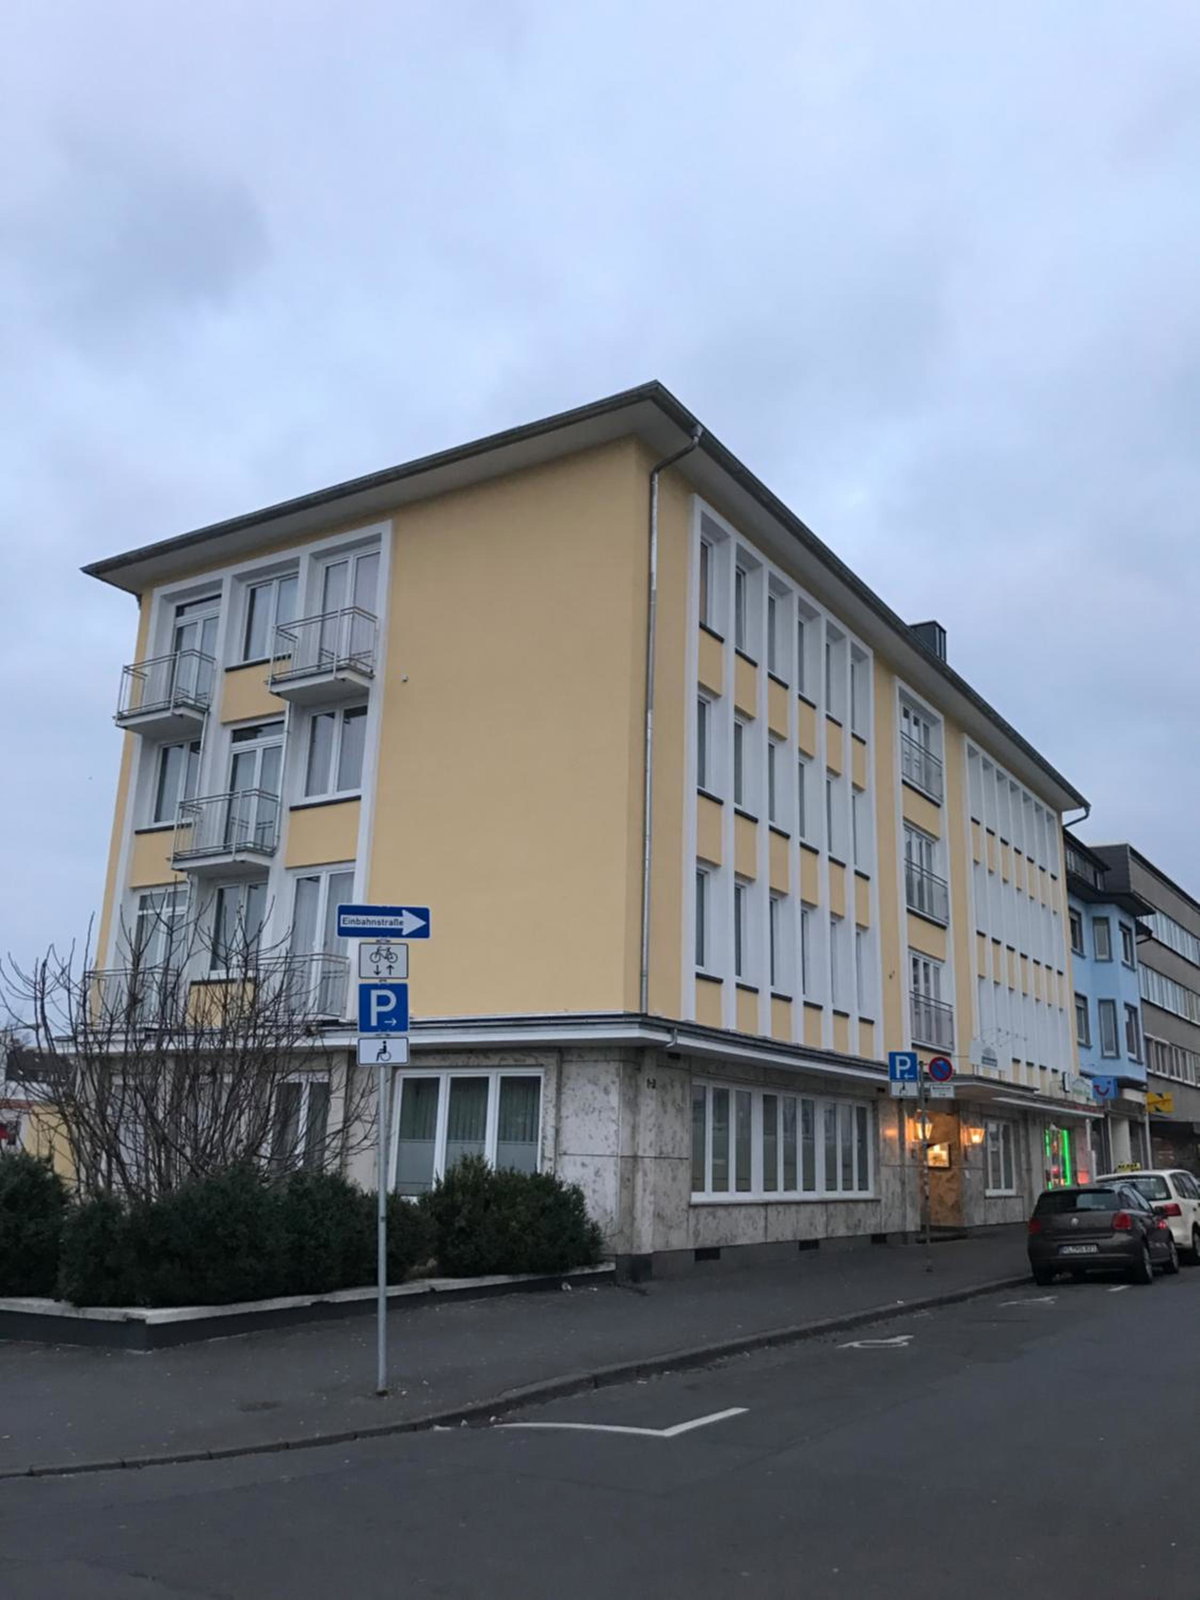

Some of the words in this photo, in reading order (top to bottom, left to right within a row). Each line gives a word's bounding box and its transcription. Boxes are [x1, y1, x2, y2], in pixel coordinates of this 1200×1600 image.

[342, 916, 404, 927] Einbahnstraße
[370, 989, 397, 1027] P
[895, 1055, 911, 1079] P
